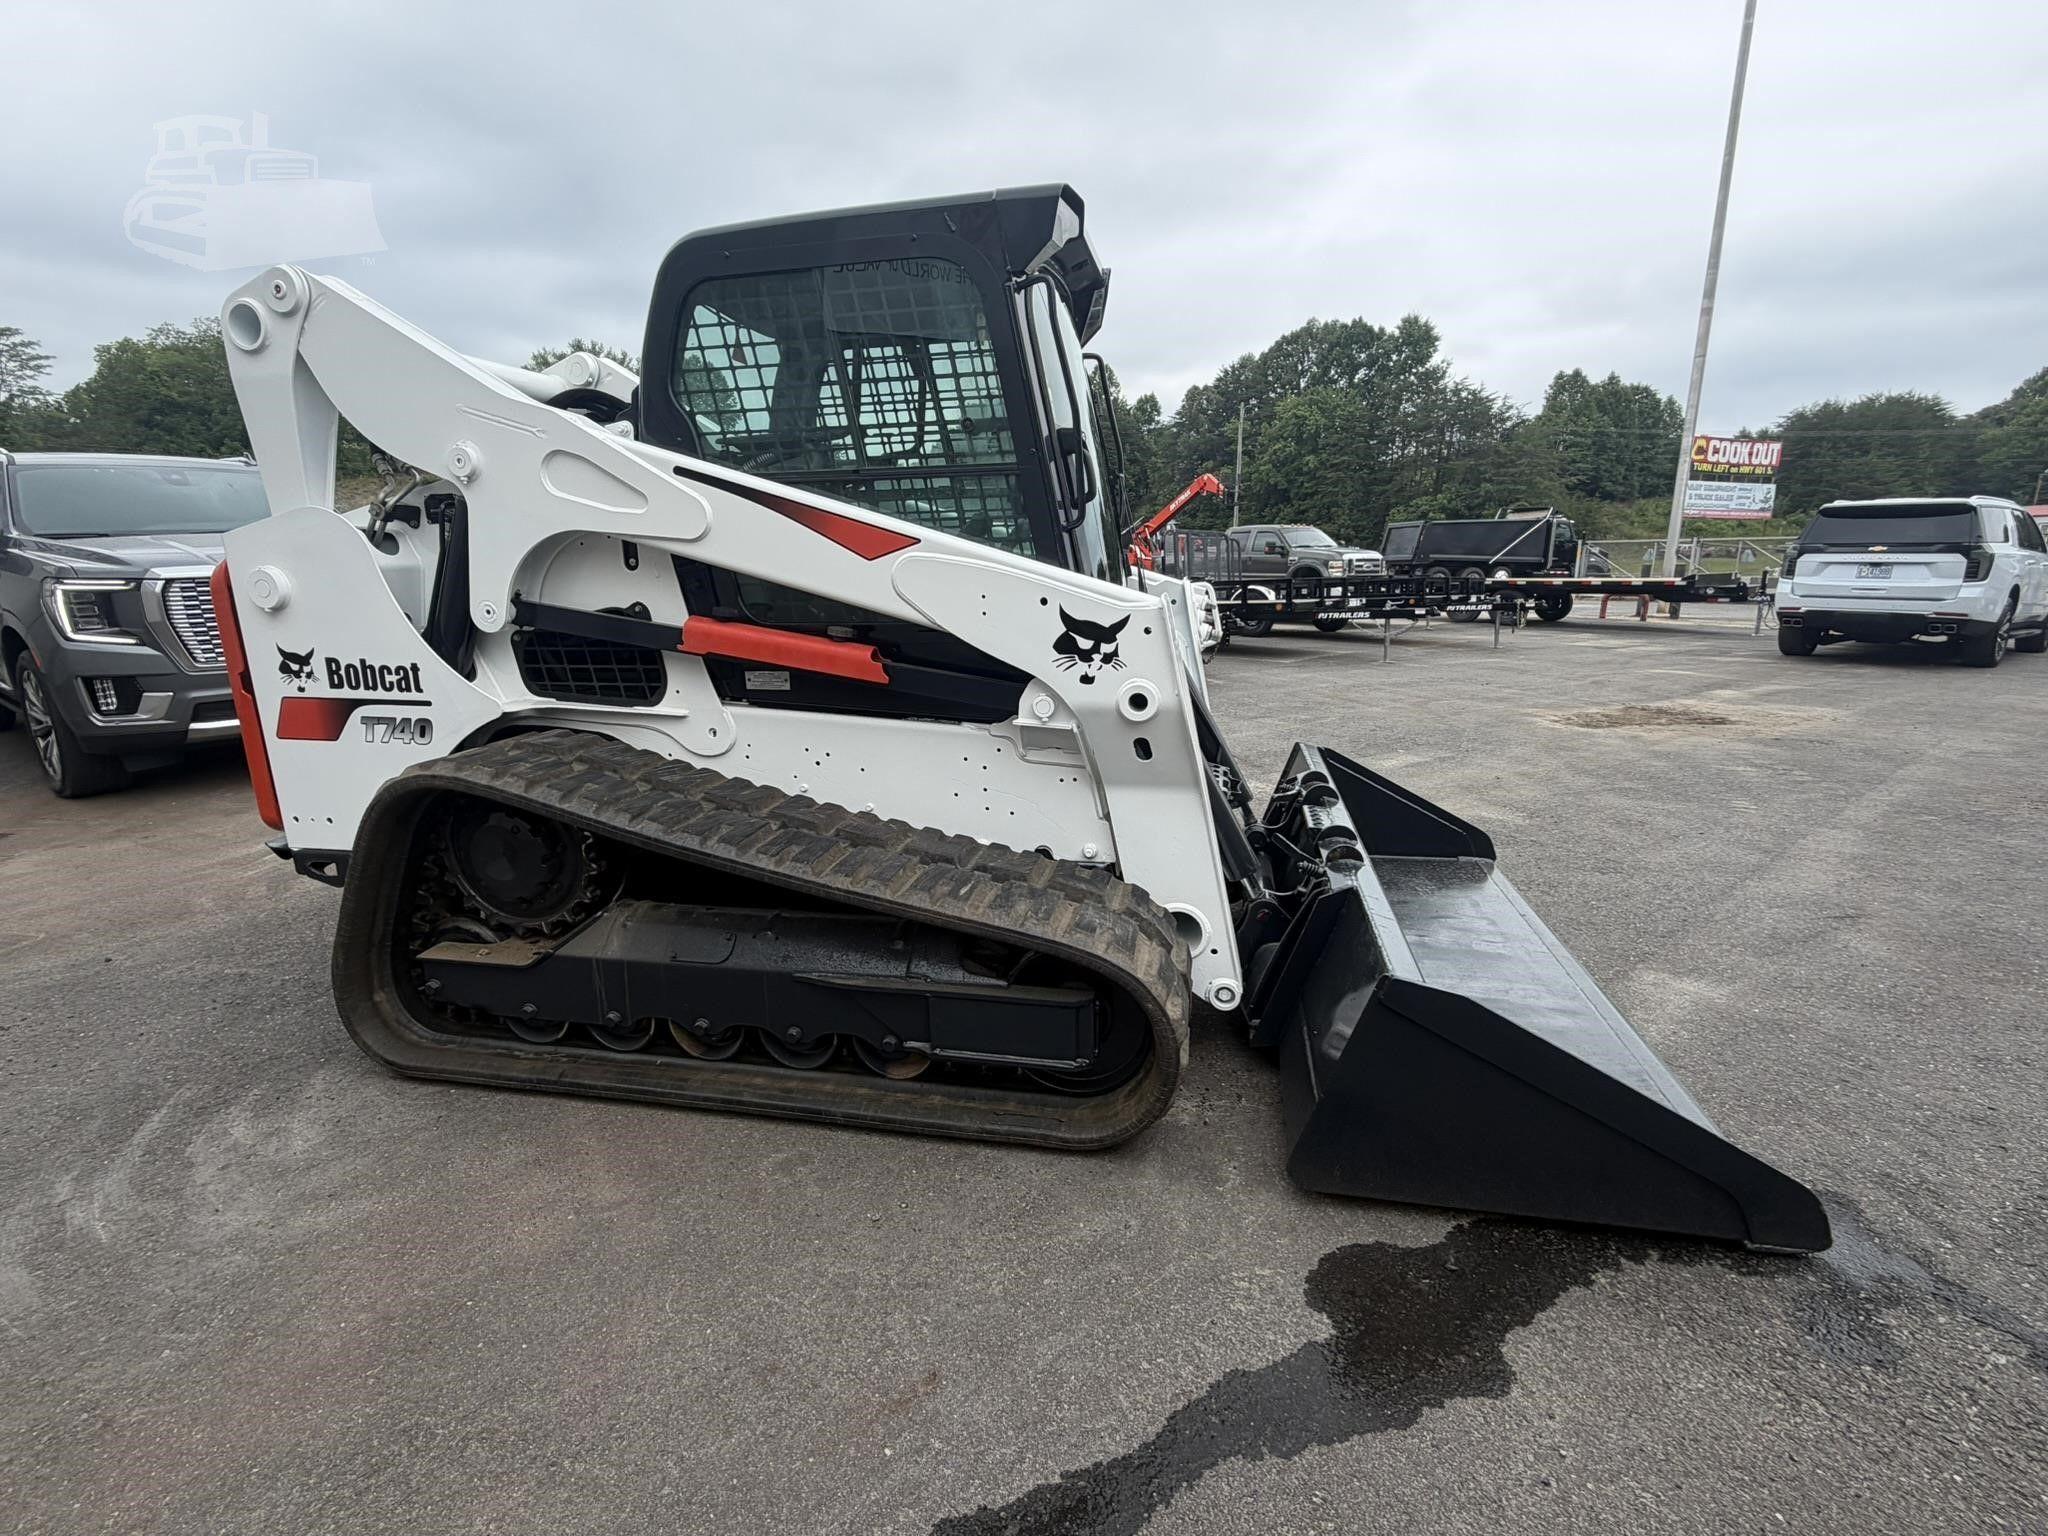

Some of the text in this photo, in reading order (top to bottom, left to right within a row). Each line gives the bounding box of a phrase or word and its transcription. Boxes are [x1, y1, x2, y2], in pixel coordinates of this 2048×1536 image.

[1707, 439, 1782, 465] COOK OUT
[1693, 462, 1713, 471] TURN
[1713, 463, 1729, 473] LEFT
[1739, 465, 1754, 474] HWY
[1327, 611, 1370, 619] TRAILERS
[324, 656, 424, 694] Bobcat
[360, 715, 434, 746] T740
